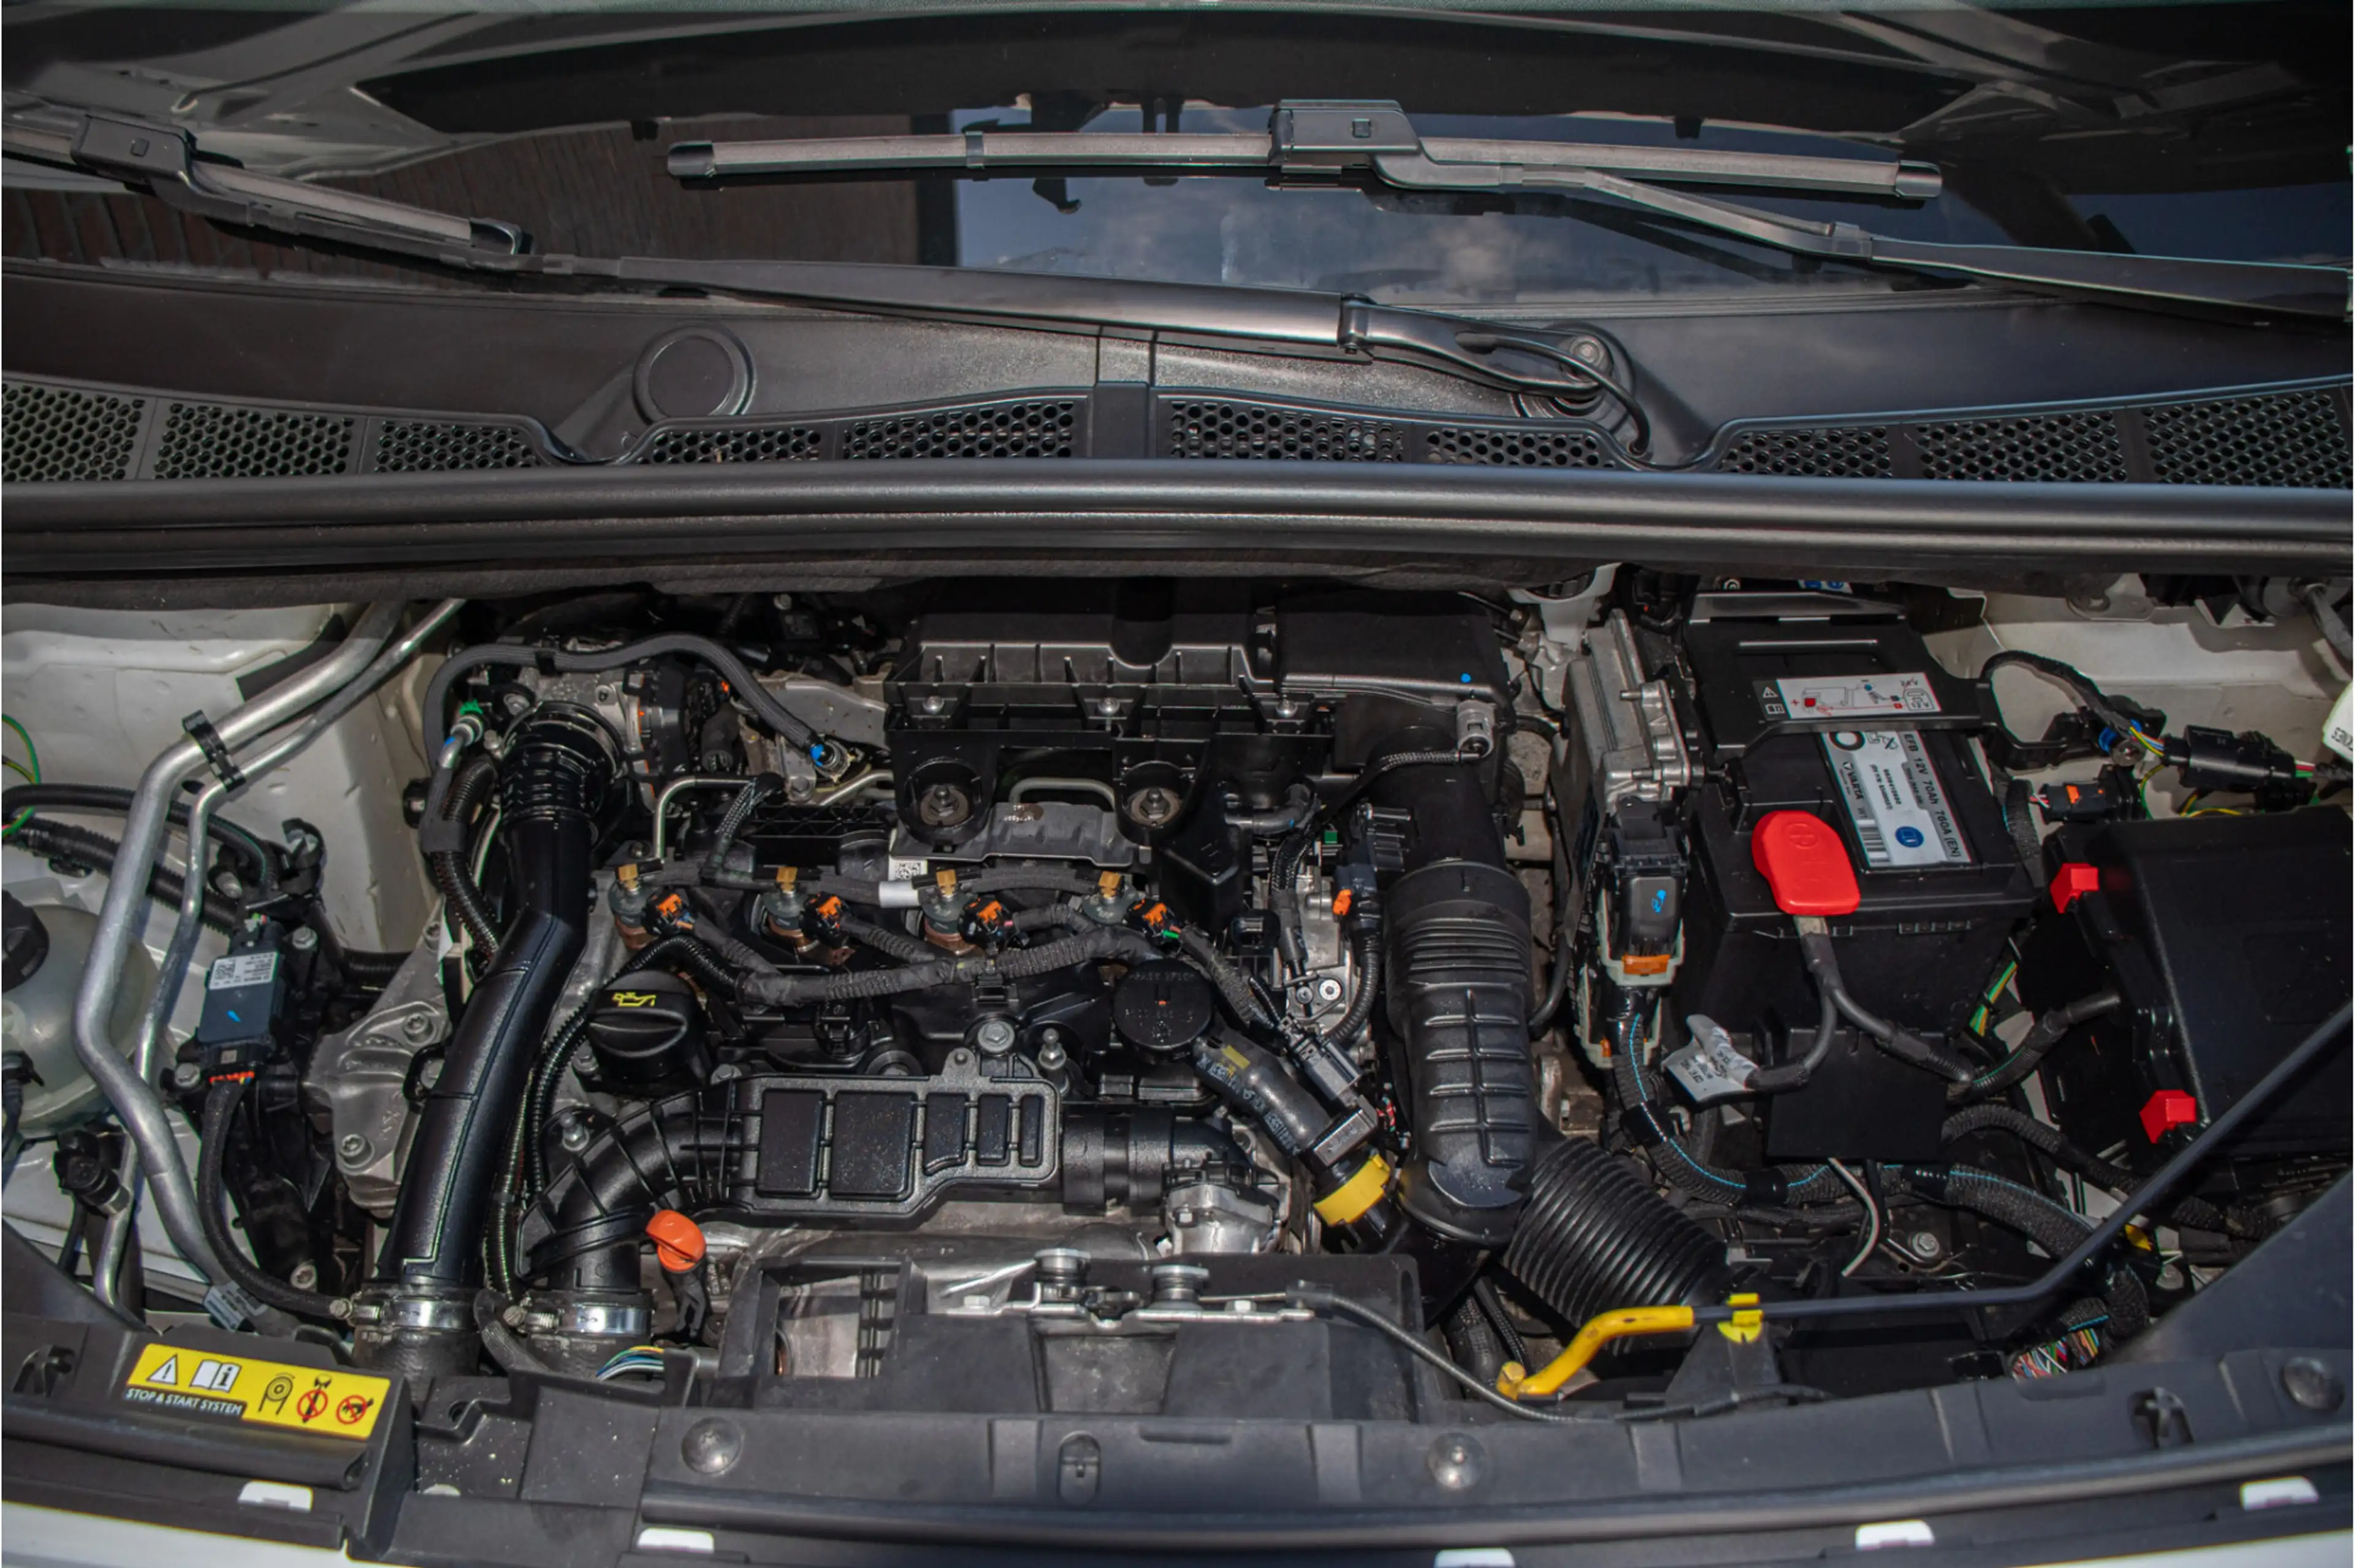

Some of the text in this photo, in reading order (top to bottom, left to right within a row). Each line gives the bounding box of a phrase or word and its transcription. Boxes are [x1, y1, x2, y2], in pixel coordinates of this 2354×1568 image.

[1848, 771, 1864, 800] VARTA
[1904, 734, 1919, 752] EFB
[1914, 758, 1928, 774] 12V
[1923, 780, 1939, 804] 70Ah
[1945, 837, 1961, 857] (EN)
[125, 1388, 243, 1416] STOP & START SYSTEM
